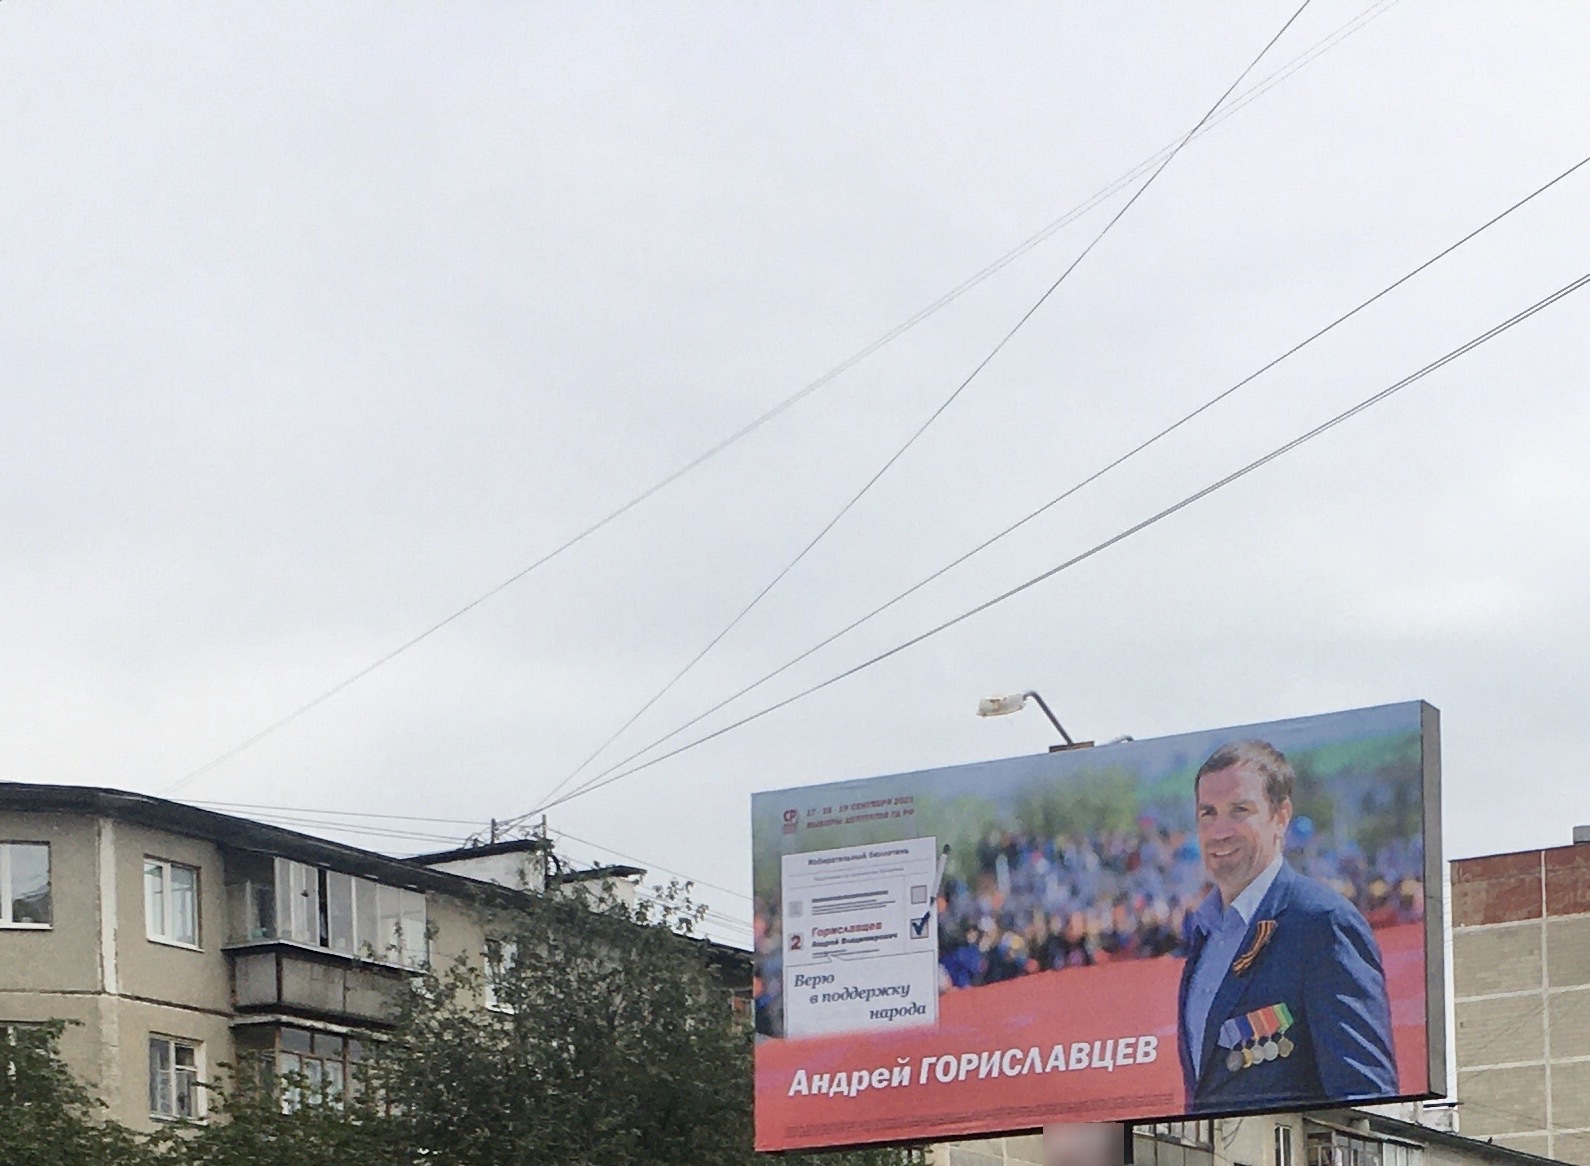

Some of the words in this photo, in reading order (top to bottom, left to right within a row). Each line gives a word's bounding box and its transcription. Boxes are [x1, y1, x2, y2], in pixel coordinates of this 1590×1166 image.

[811, 921, 883, 938] Гориславцев
[790, 934, 802, 951] 2
[794, 974, 835, 989] Верю
[809, 994, 819, 1004] в
[822, 984, 911, 1003] поддержку
[869, 1002, 927, 1021] народа
[788, 1057, 911, 1097] Андрей
[919, 1035, 1159, 1084] ГОРИСЛАВЦЕВ
